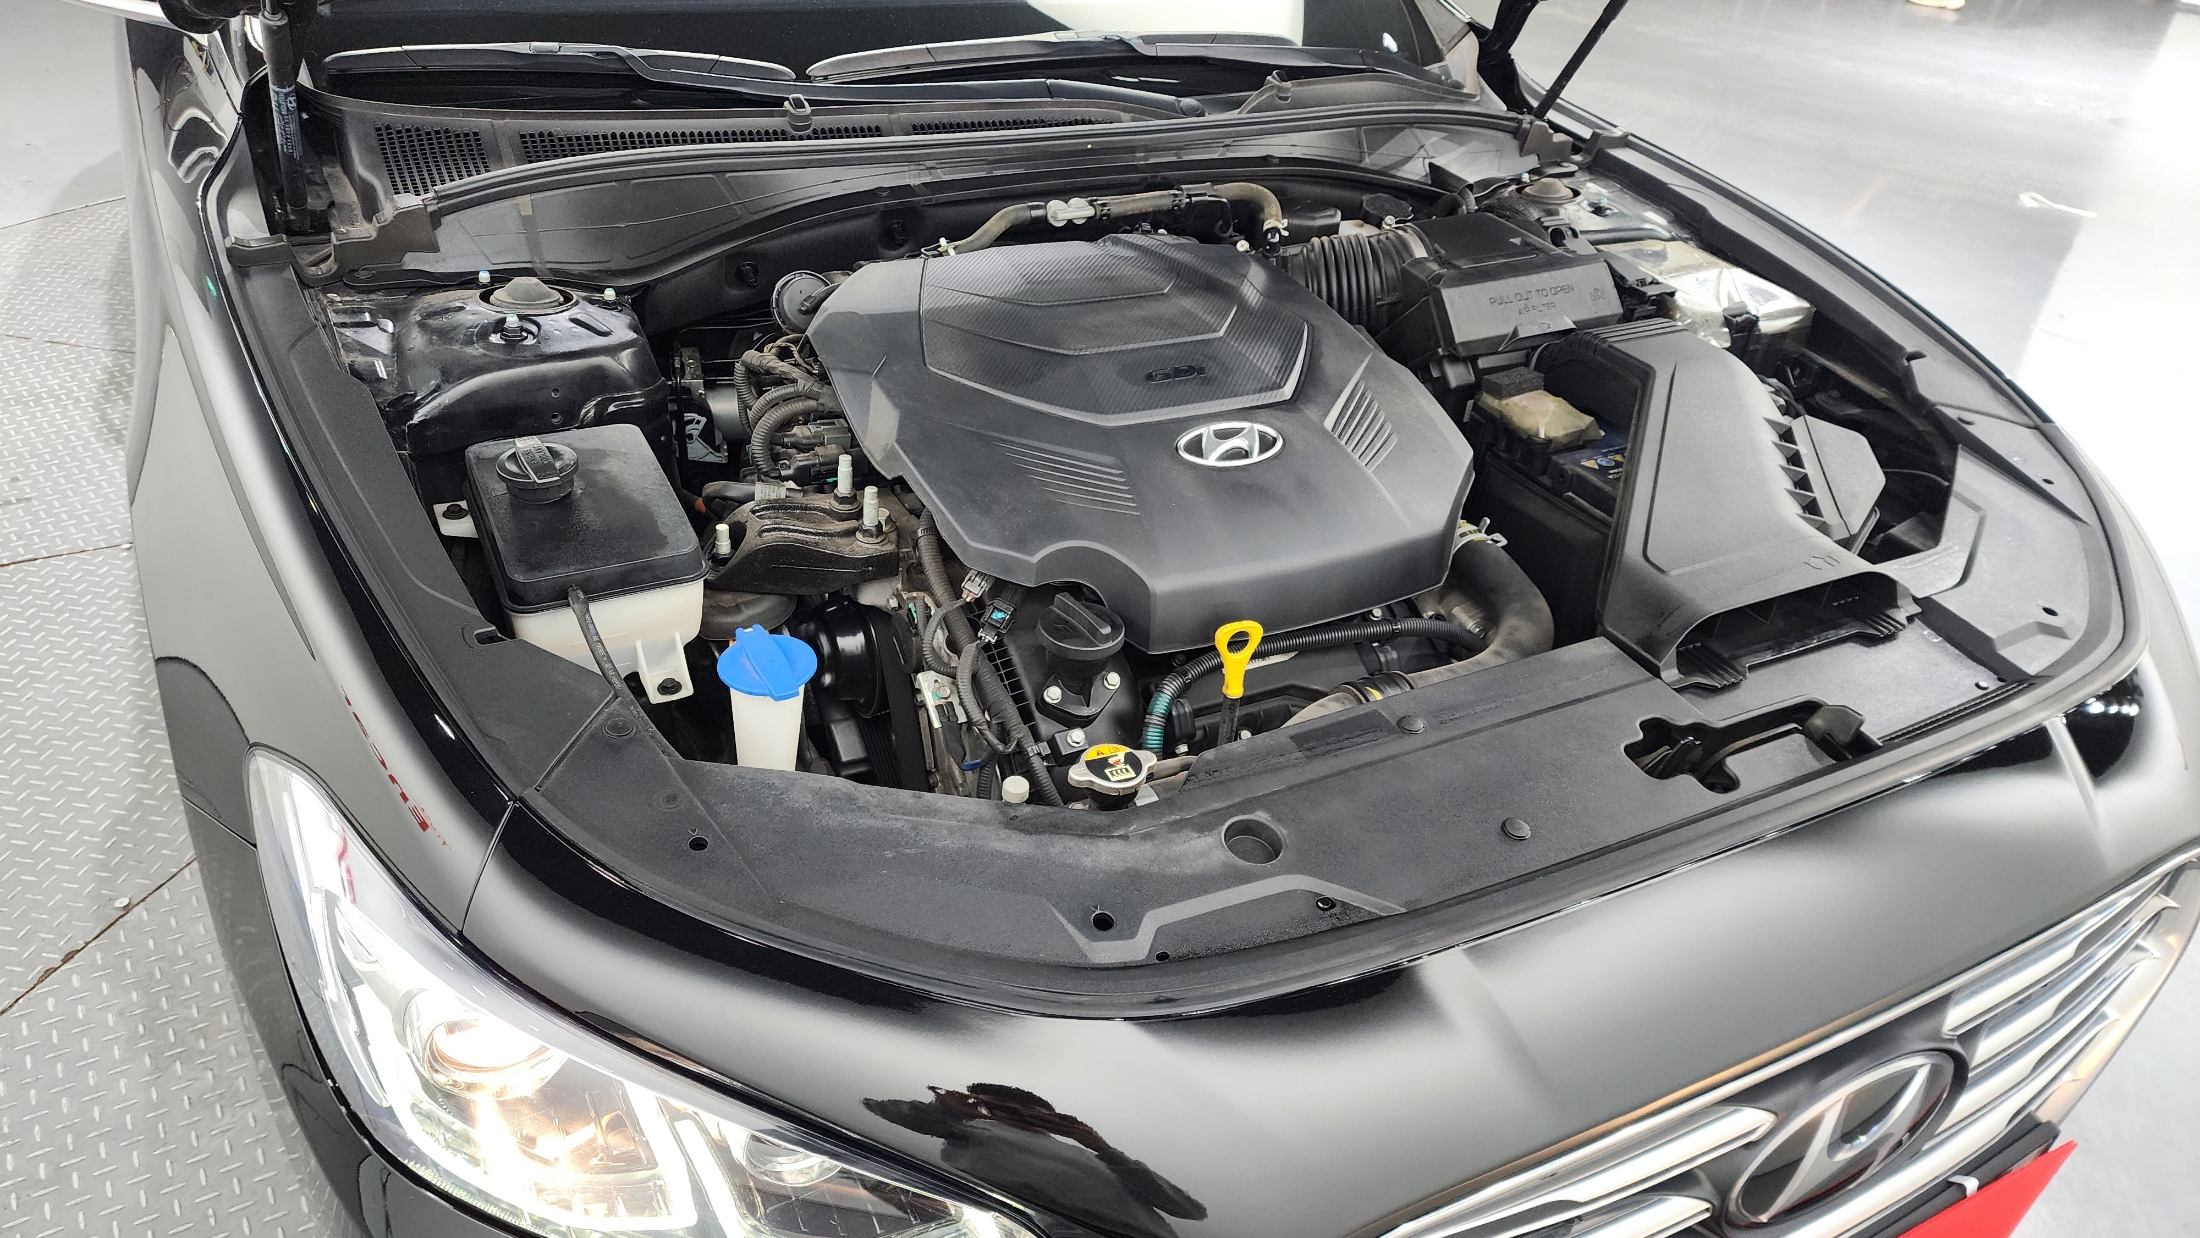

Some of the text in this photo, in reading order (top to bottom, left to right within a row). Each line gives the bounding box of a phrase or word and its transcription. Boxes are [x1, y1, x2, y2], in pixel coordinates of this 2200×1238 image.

[1489, 283, 1575, 306] PULL OUT TO OPEN
